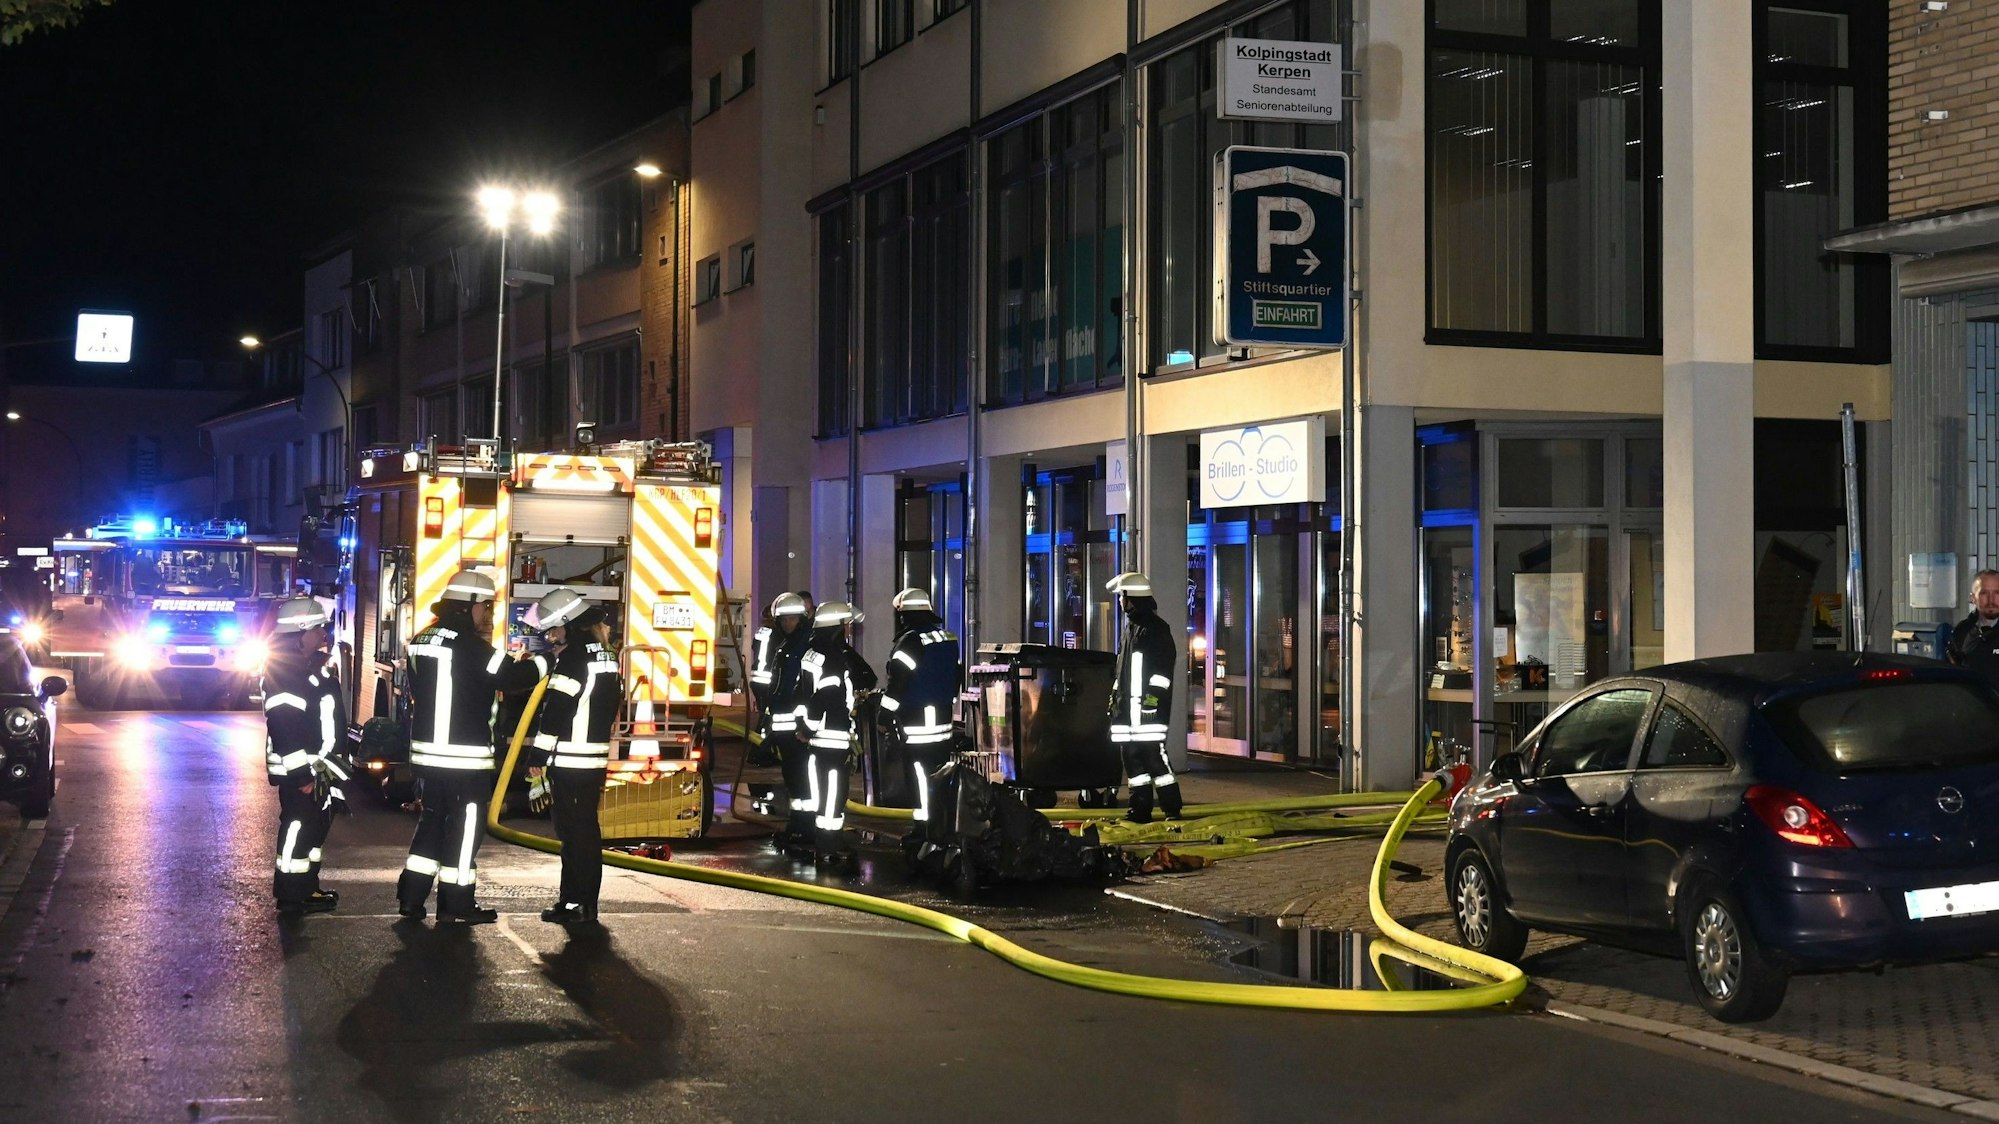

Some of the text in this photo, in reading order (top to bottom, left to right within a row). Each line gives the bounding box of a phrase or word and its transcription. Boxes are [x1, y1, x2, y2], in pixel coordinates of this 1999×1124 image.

[1236, 45, 1332, 62] Kolpingstadt
[1258, 63, 1311, 79] Kerpen
[1252, 84, 1316, 97] Standesamt
[1236, 99, 1332, 116] Seniorenabteilung
[1257, 195, 1316, 274] P
[1243, 280, 1332, 297] Stiftsquartier
[1256, 306, 1316, 323] EINFAHRT
[1208, 462, 1246, 480] Brillen
[1256, 457, 1298, 475] Studio
[152, 599, 236, 612] FEUERWEHR
